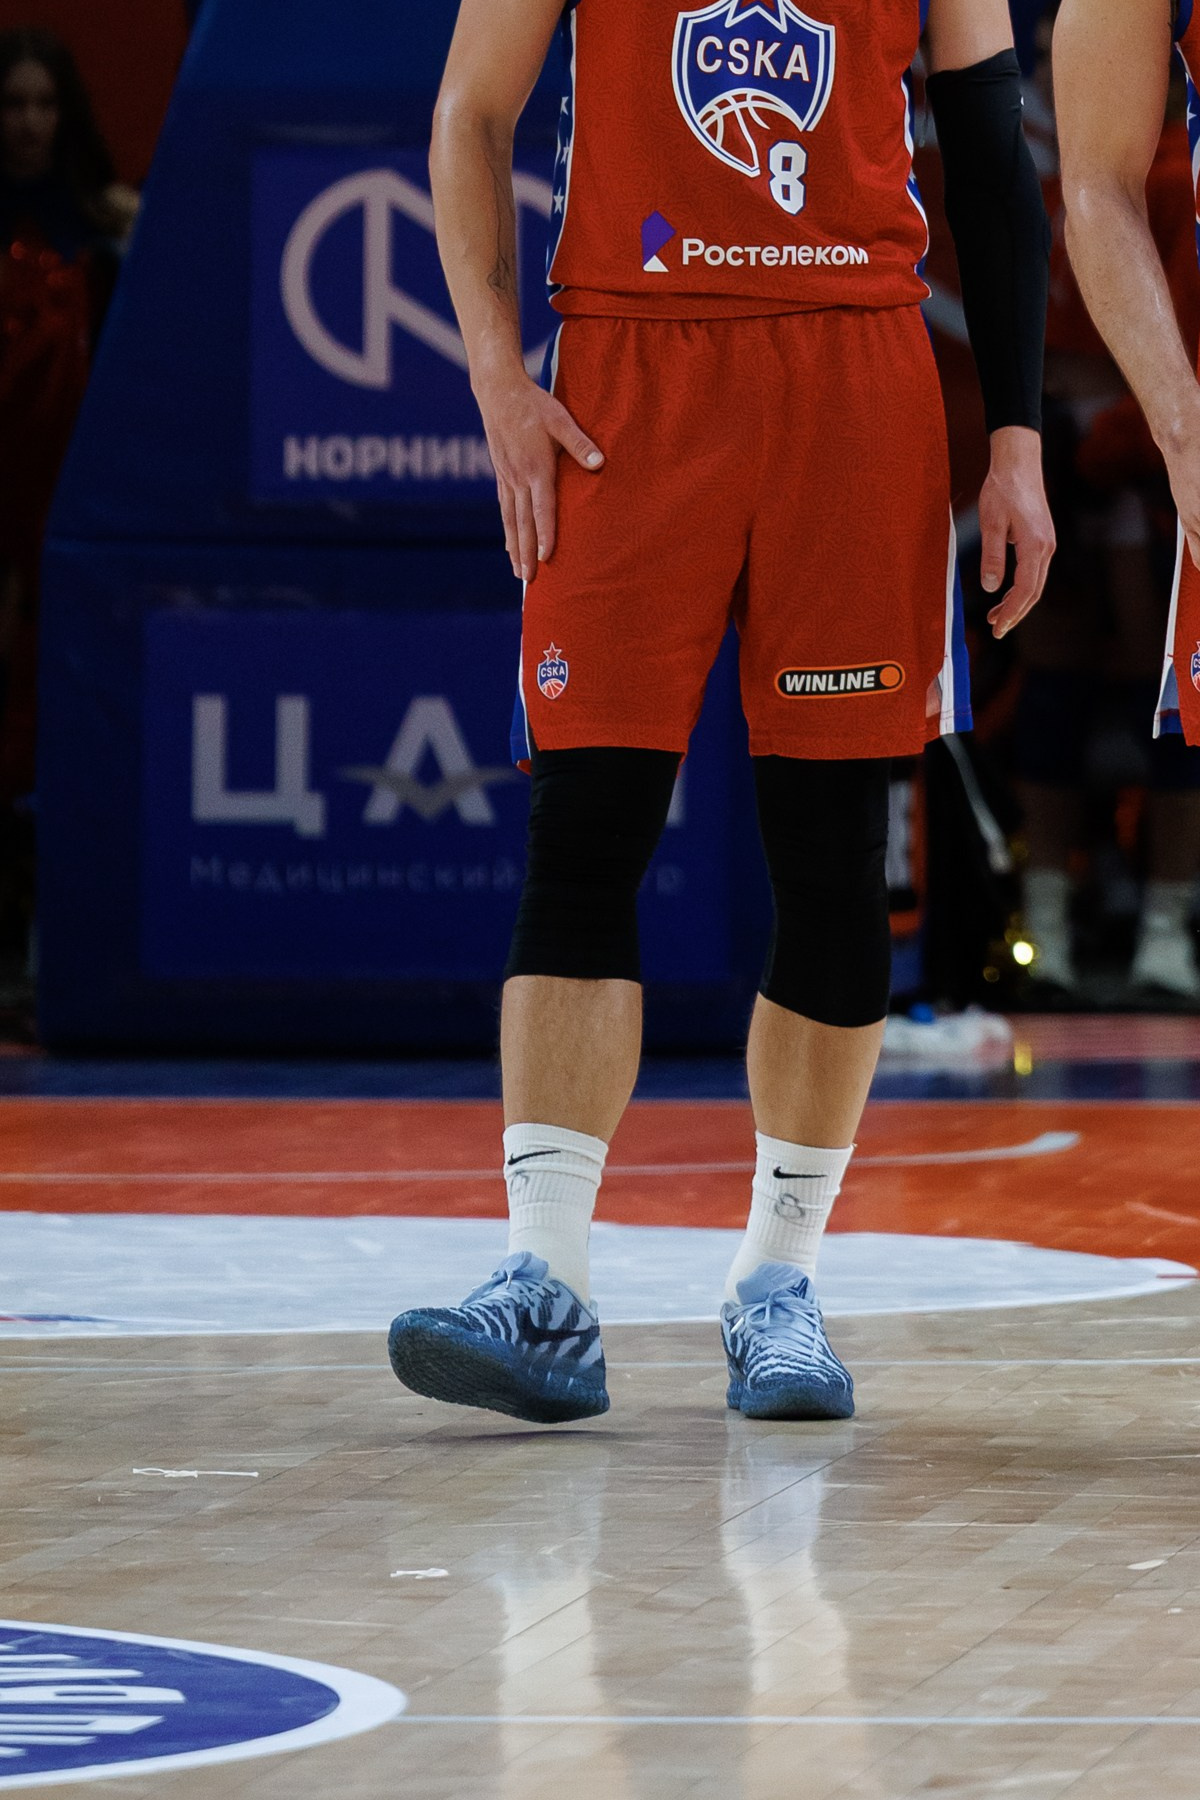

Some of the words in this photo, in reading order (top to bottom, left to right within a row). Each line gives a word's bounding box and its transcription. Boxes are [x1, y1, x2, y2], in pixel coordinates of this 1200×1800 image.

[696, 33, 810, 83] CSKA
[768, 140, 808, 216] 8
[682, 238, 869, 266] Ростелеком
[540, 665, 566, 678] CSKA
[785, 670, 876, 692] WINLINE
[191, 693, 687, 837] ЦА
